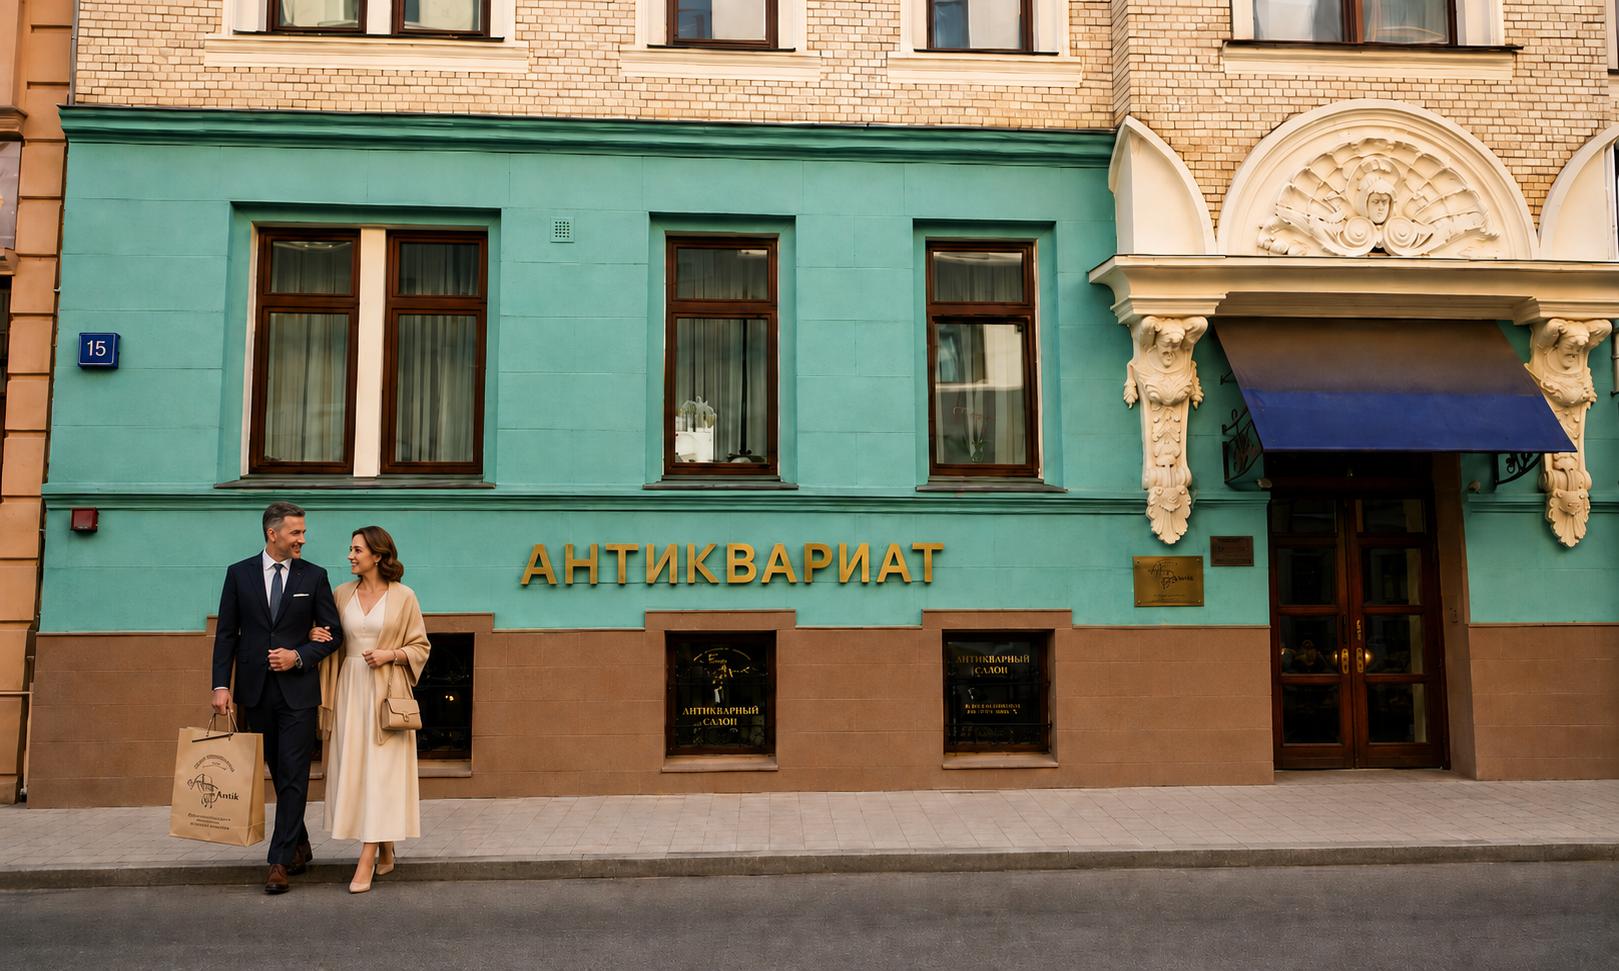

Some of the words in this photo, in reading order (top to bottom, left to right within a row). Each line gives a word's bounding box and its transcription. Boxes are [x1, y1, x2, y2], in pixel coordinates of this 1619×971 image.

[87, 340, 106, 357] 15
[520, 542, 945, 586] АНТИКВАРИАТ
[682, 705, 759, 715] АНТИКВАРНЫЙ
[215, 790, 239, 801] Antik
